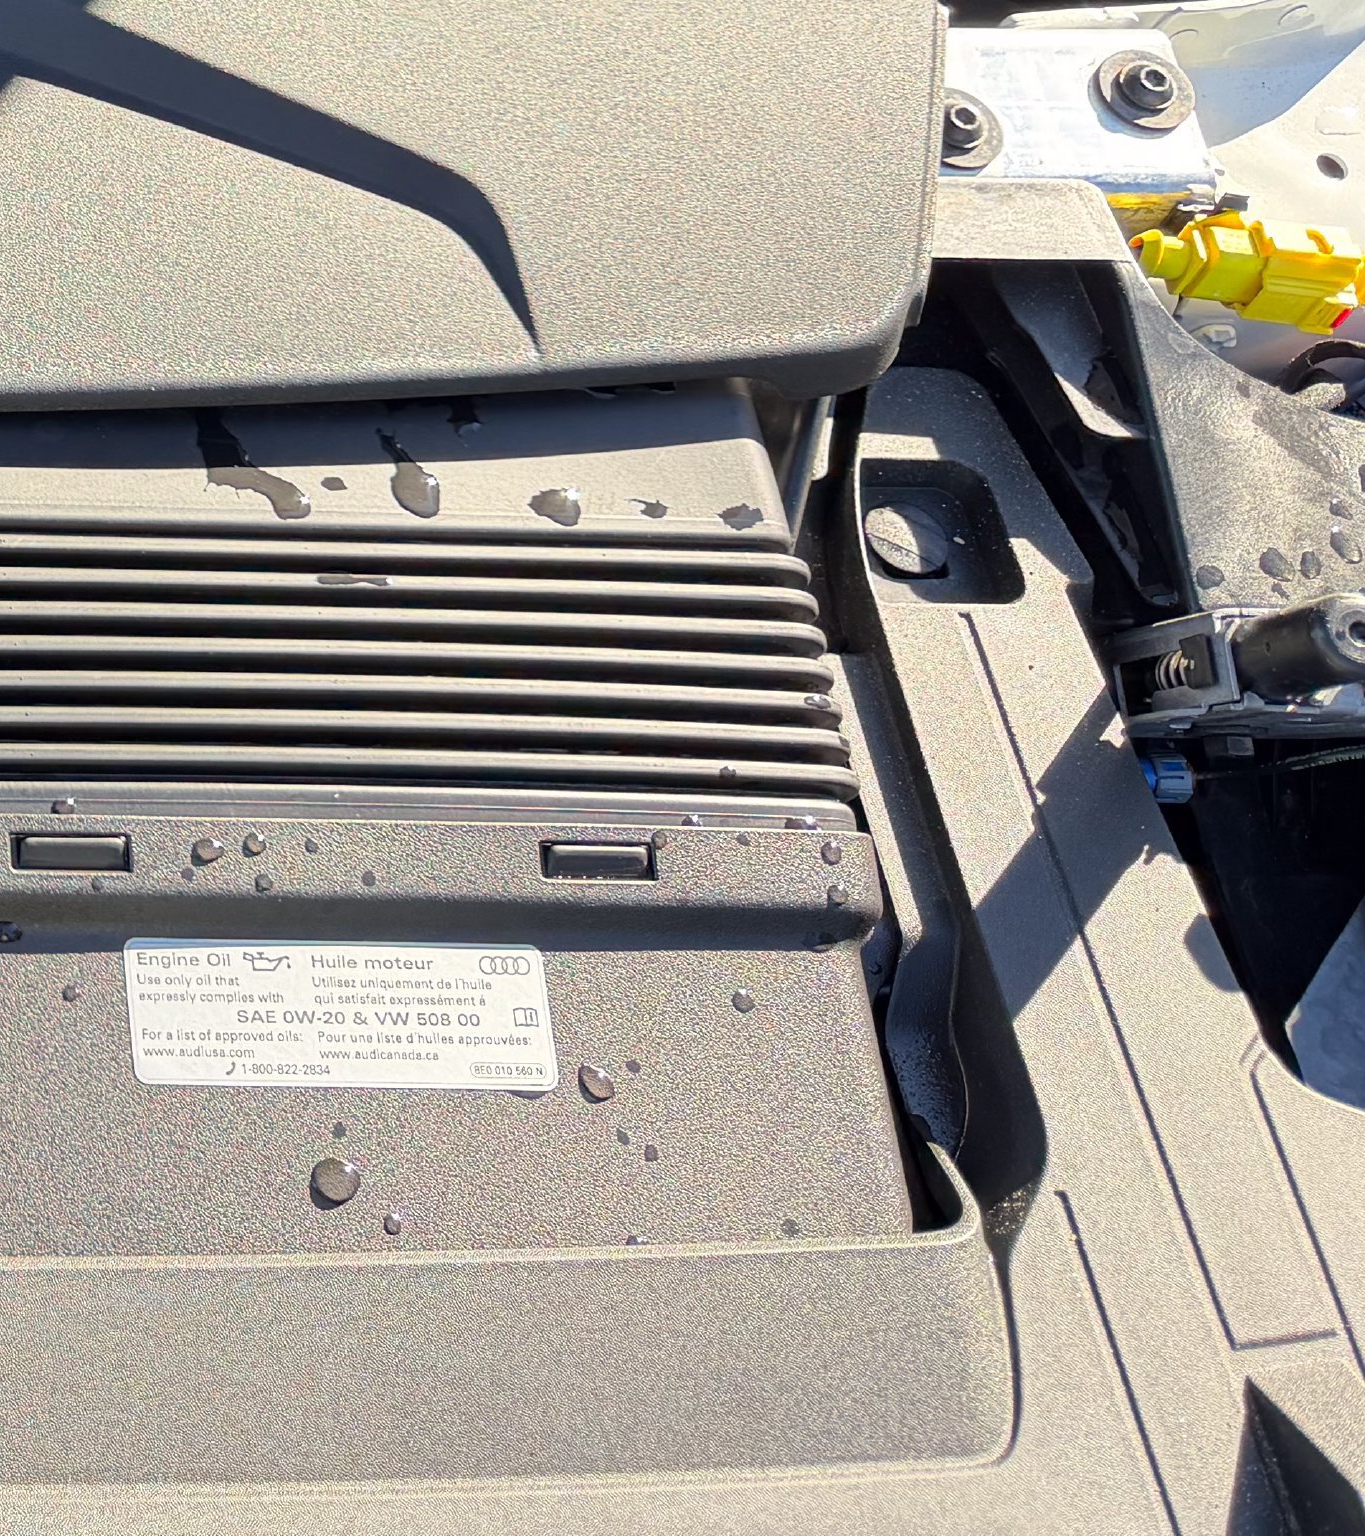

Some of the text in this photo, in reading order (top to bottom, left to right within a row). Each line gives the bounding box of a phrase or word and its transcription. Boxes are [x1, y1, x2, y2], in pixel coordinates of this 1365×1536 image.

[137, 952, 231, 968] Engine Oil
[312, 955, 433, 970] Huile moteur
[137, 974, 239, 987] Use only oil that
[312, 977, 492, 991] Utilisez uniquement de l'huile
[139, 991, 284, 1004] expressly complies with
[315, 995, 335, 1005] qui
[338, 994, 386, 1005] satisfait
[389, 995, 476, 1007] expressément
[237, 1010, 480, 1026] SAE 0W-20 & VW 508 00
[142, 1029, 303, 1044] For a list of approved oils:
[318, 1031, 532, 1047] Pour une liste d'huiles approuvées:
[143, 1046, 255, 1058] www.audiusa.com
[320, 1049, 439, 1061] www.audicanada.ca
[241, 1064, 330, 1075] 1-800-822-2834
[494, 1066, 513, 1075] 010
[535, 1067, 543, 1076] N
